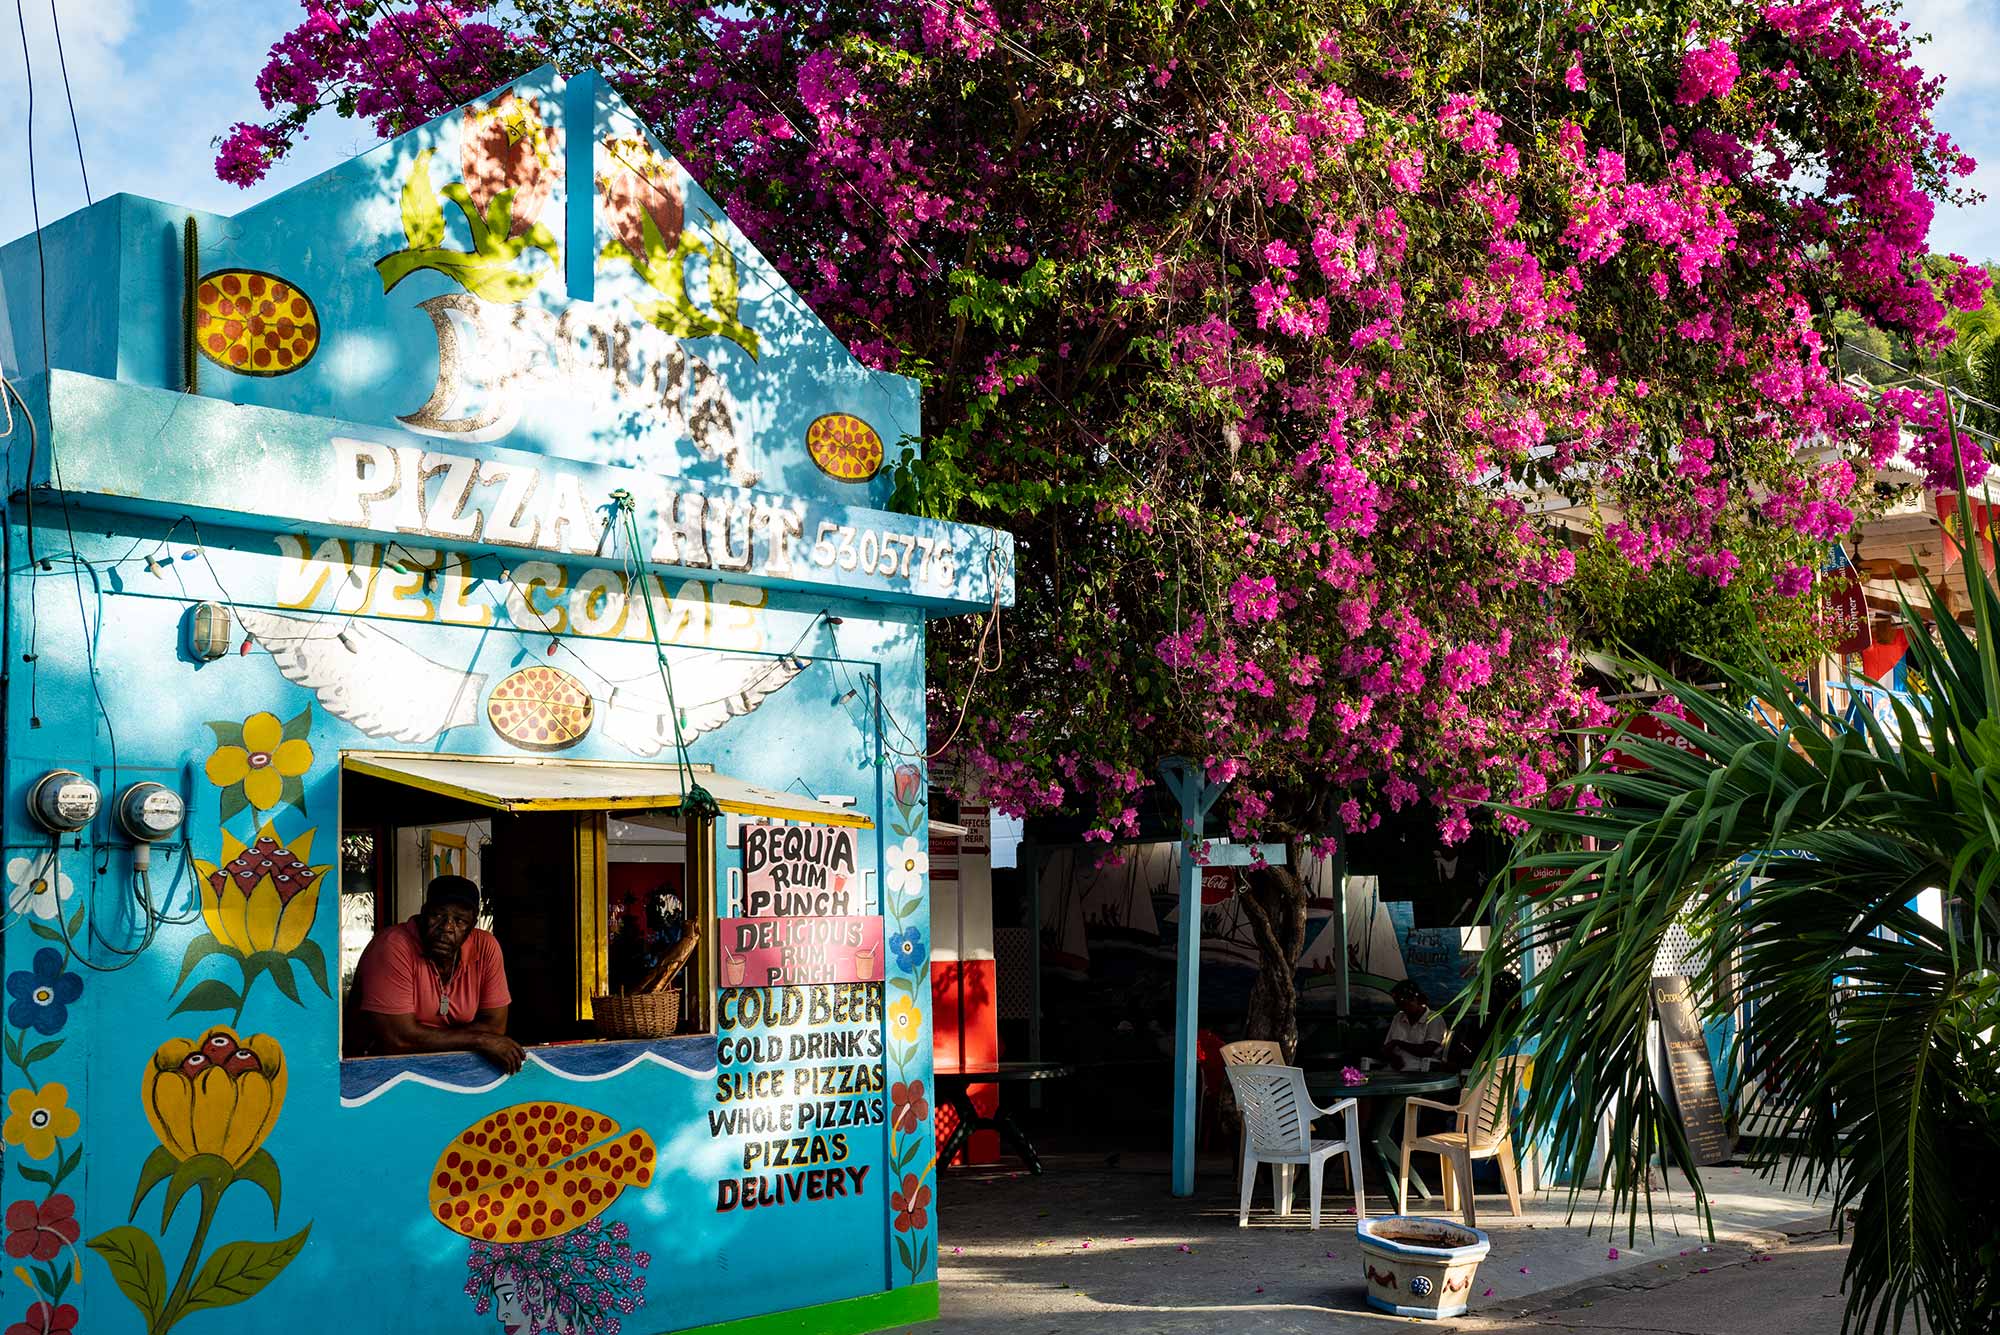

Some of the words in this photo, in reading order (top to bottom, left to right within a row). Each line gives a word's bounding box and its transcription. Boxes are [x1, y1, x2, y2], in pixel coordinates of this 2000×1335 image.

[329, 437, 602, 558] PIZZA
[650, 491, 803, 578] HUT
[814, 521, 955, 588] 5305776
[960, 819, 990, 828] OFFICES
[964, 834, 985, 843] REAR
[769, 863, 827, 892] RUM
[750, 890, 849, 917] PUNCH
[767, 963, 837, 986] PUNCH
[781, 946, 826, 967] RUM
[717, 983, 805, 1031] COLD
[808, 981, 884, 1027] BEER
[717, 1034, 784, 1067] COLD
[788, 1029, 884, 1062] DRINK'S
[715, 1069, 785, 1104] SLICE
[793, 1063, 885, 1096] PIZZAS
[708, 1103, 794, 1138] WHOLE
[798, 1098, 884, 1131] PIZZA'S
[743, 1133, 848, 1172] PIZZA'S
[716, 1165, 870, 1213] DELIVERY
